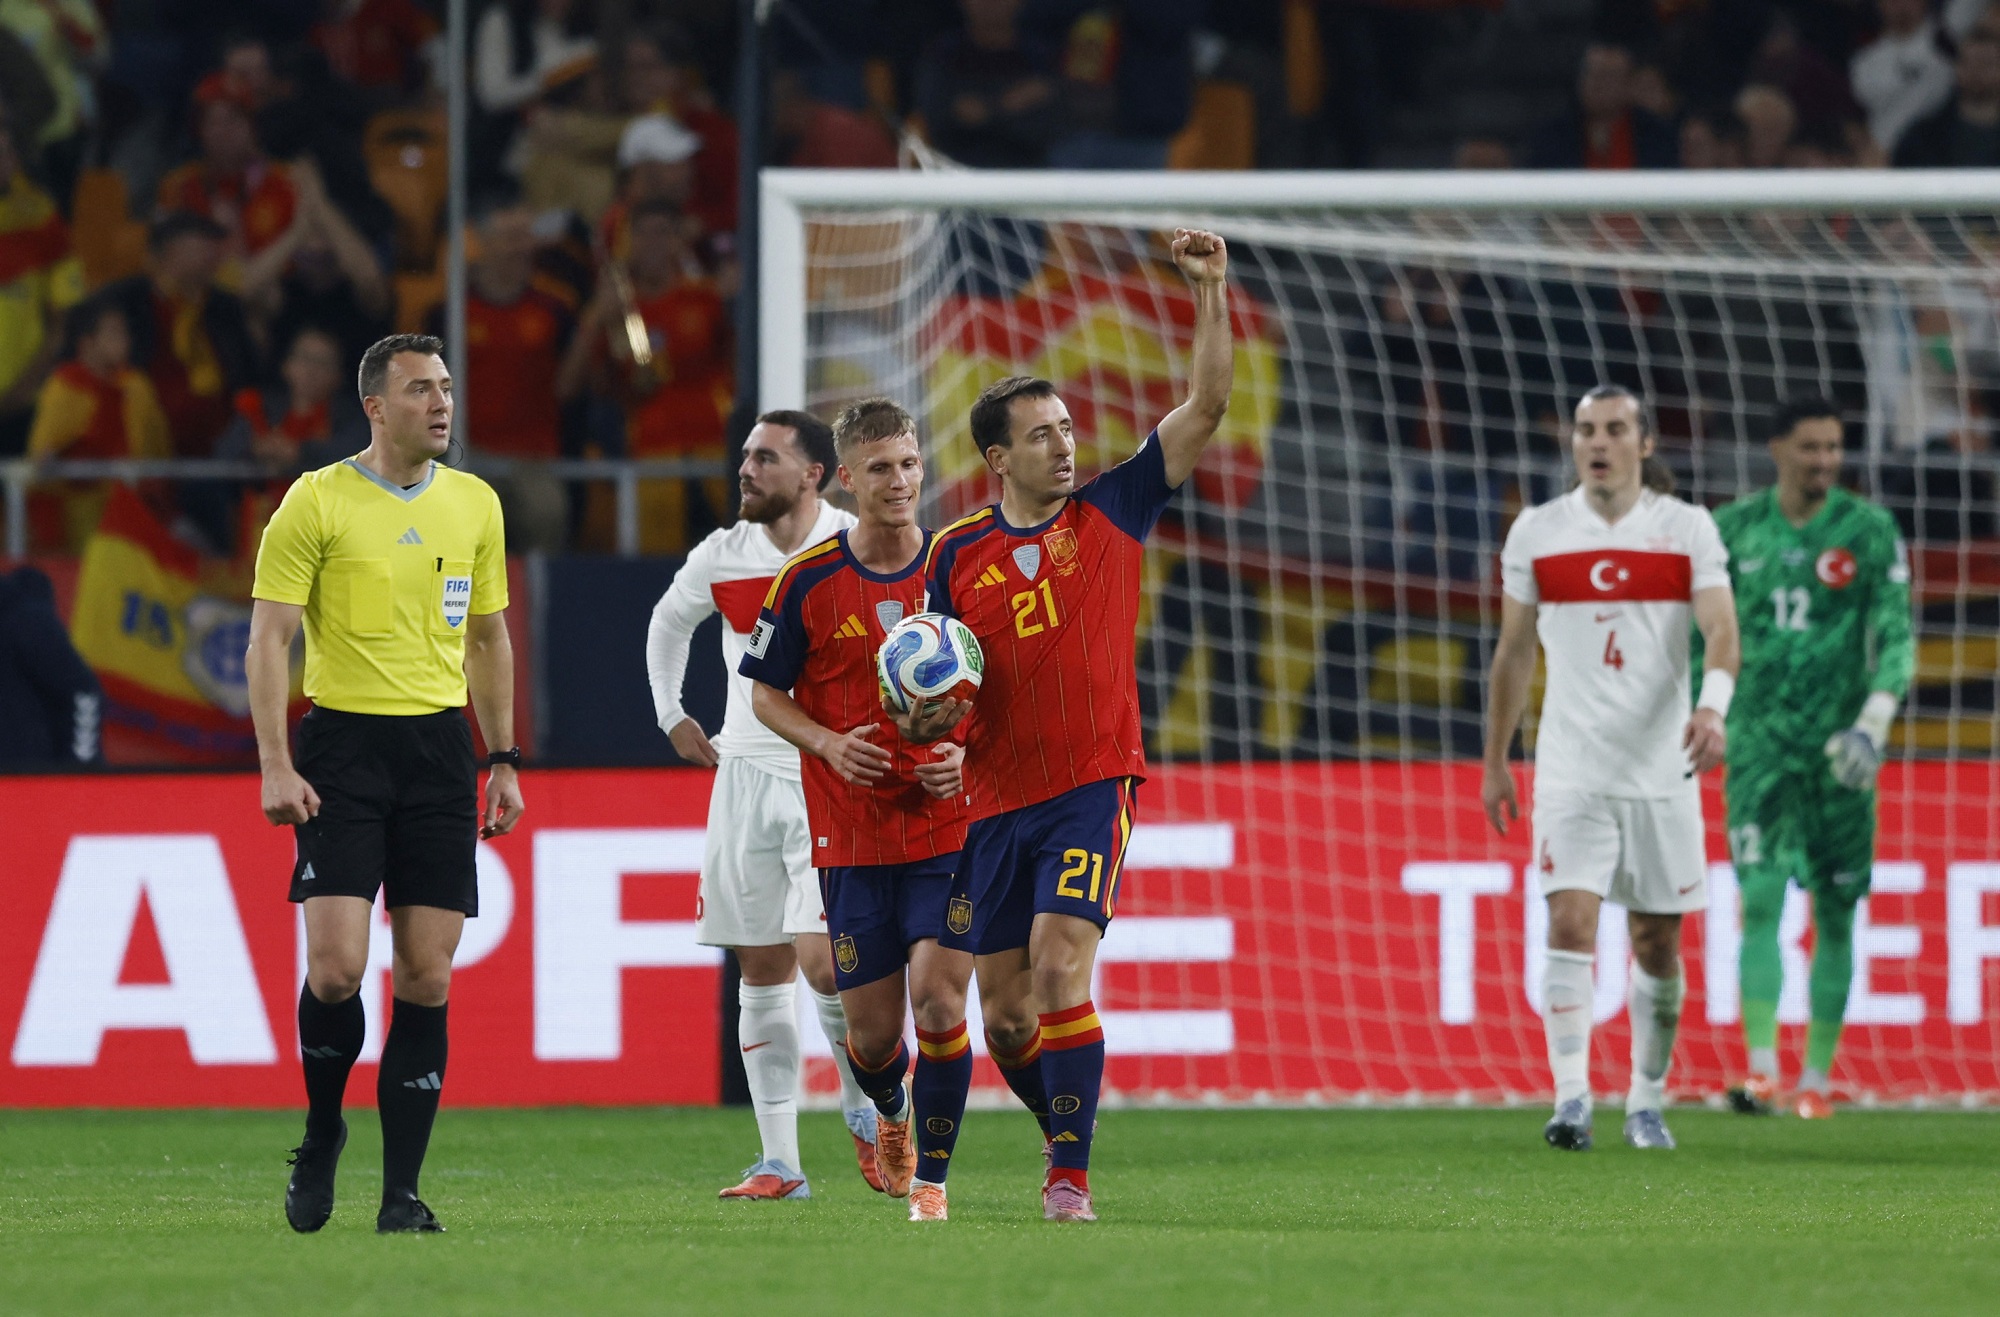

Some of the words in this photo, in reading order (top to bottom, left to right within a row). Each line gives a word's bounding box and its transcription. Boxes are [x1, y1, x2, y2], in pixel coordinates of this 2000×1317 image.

[446, 580, 469, 593] FIFA
[1011, 577, 1059, 639] 21
[1769, 585, 1811, 632] 12
[1603, 630, 1624, 671] 4
[1056, 848, 1103, 903] 21
